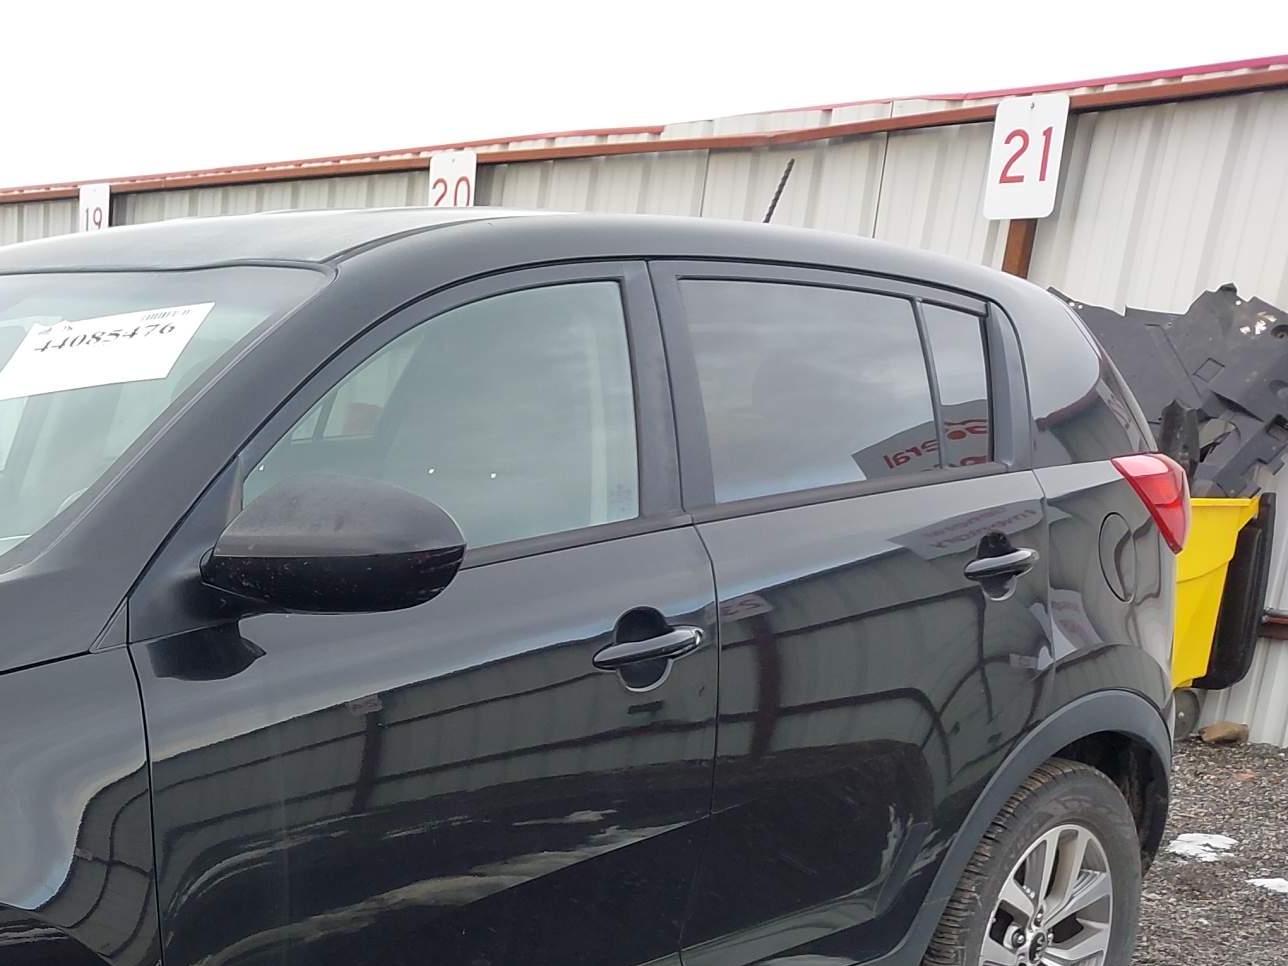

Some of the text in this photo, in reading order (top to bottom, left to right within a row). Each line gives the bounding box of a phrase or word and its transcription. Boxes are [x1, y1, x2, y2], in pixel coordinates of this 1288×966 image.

[998, 126, 1054, 184] 21
[431, 175, 471, 207] 20
[85, 206, 103, 232] 19
[33, 322, 176, 352] 44085476
